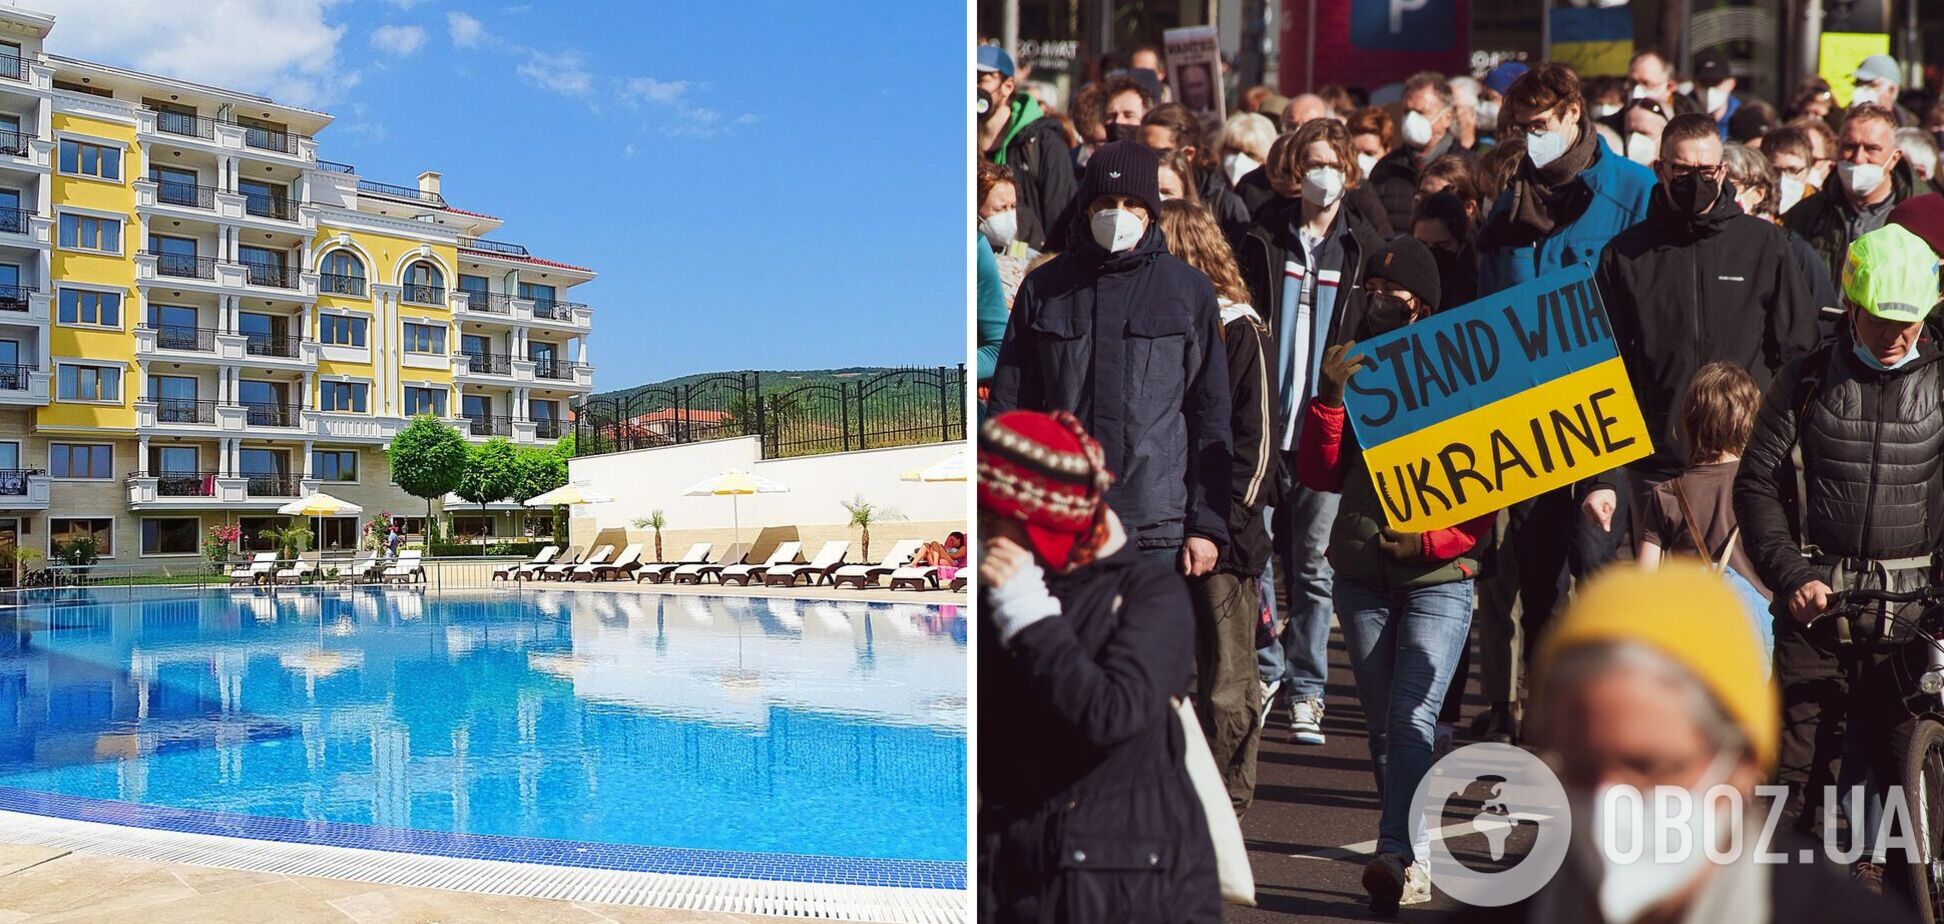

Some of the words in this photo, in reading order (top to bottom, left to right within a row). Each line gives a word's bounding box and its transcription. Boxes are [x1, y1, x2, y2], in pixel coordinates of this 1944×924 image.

[1346, 318, 1500, 427] STAND
[1502, 278, 1611, 363] WITH
[1375, 387, 1636, 523] UKRAINE
